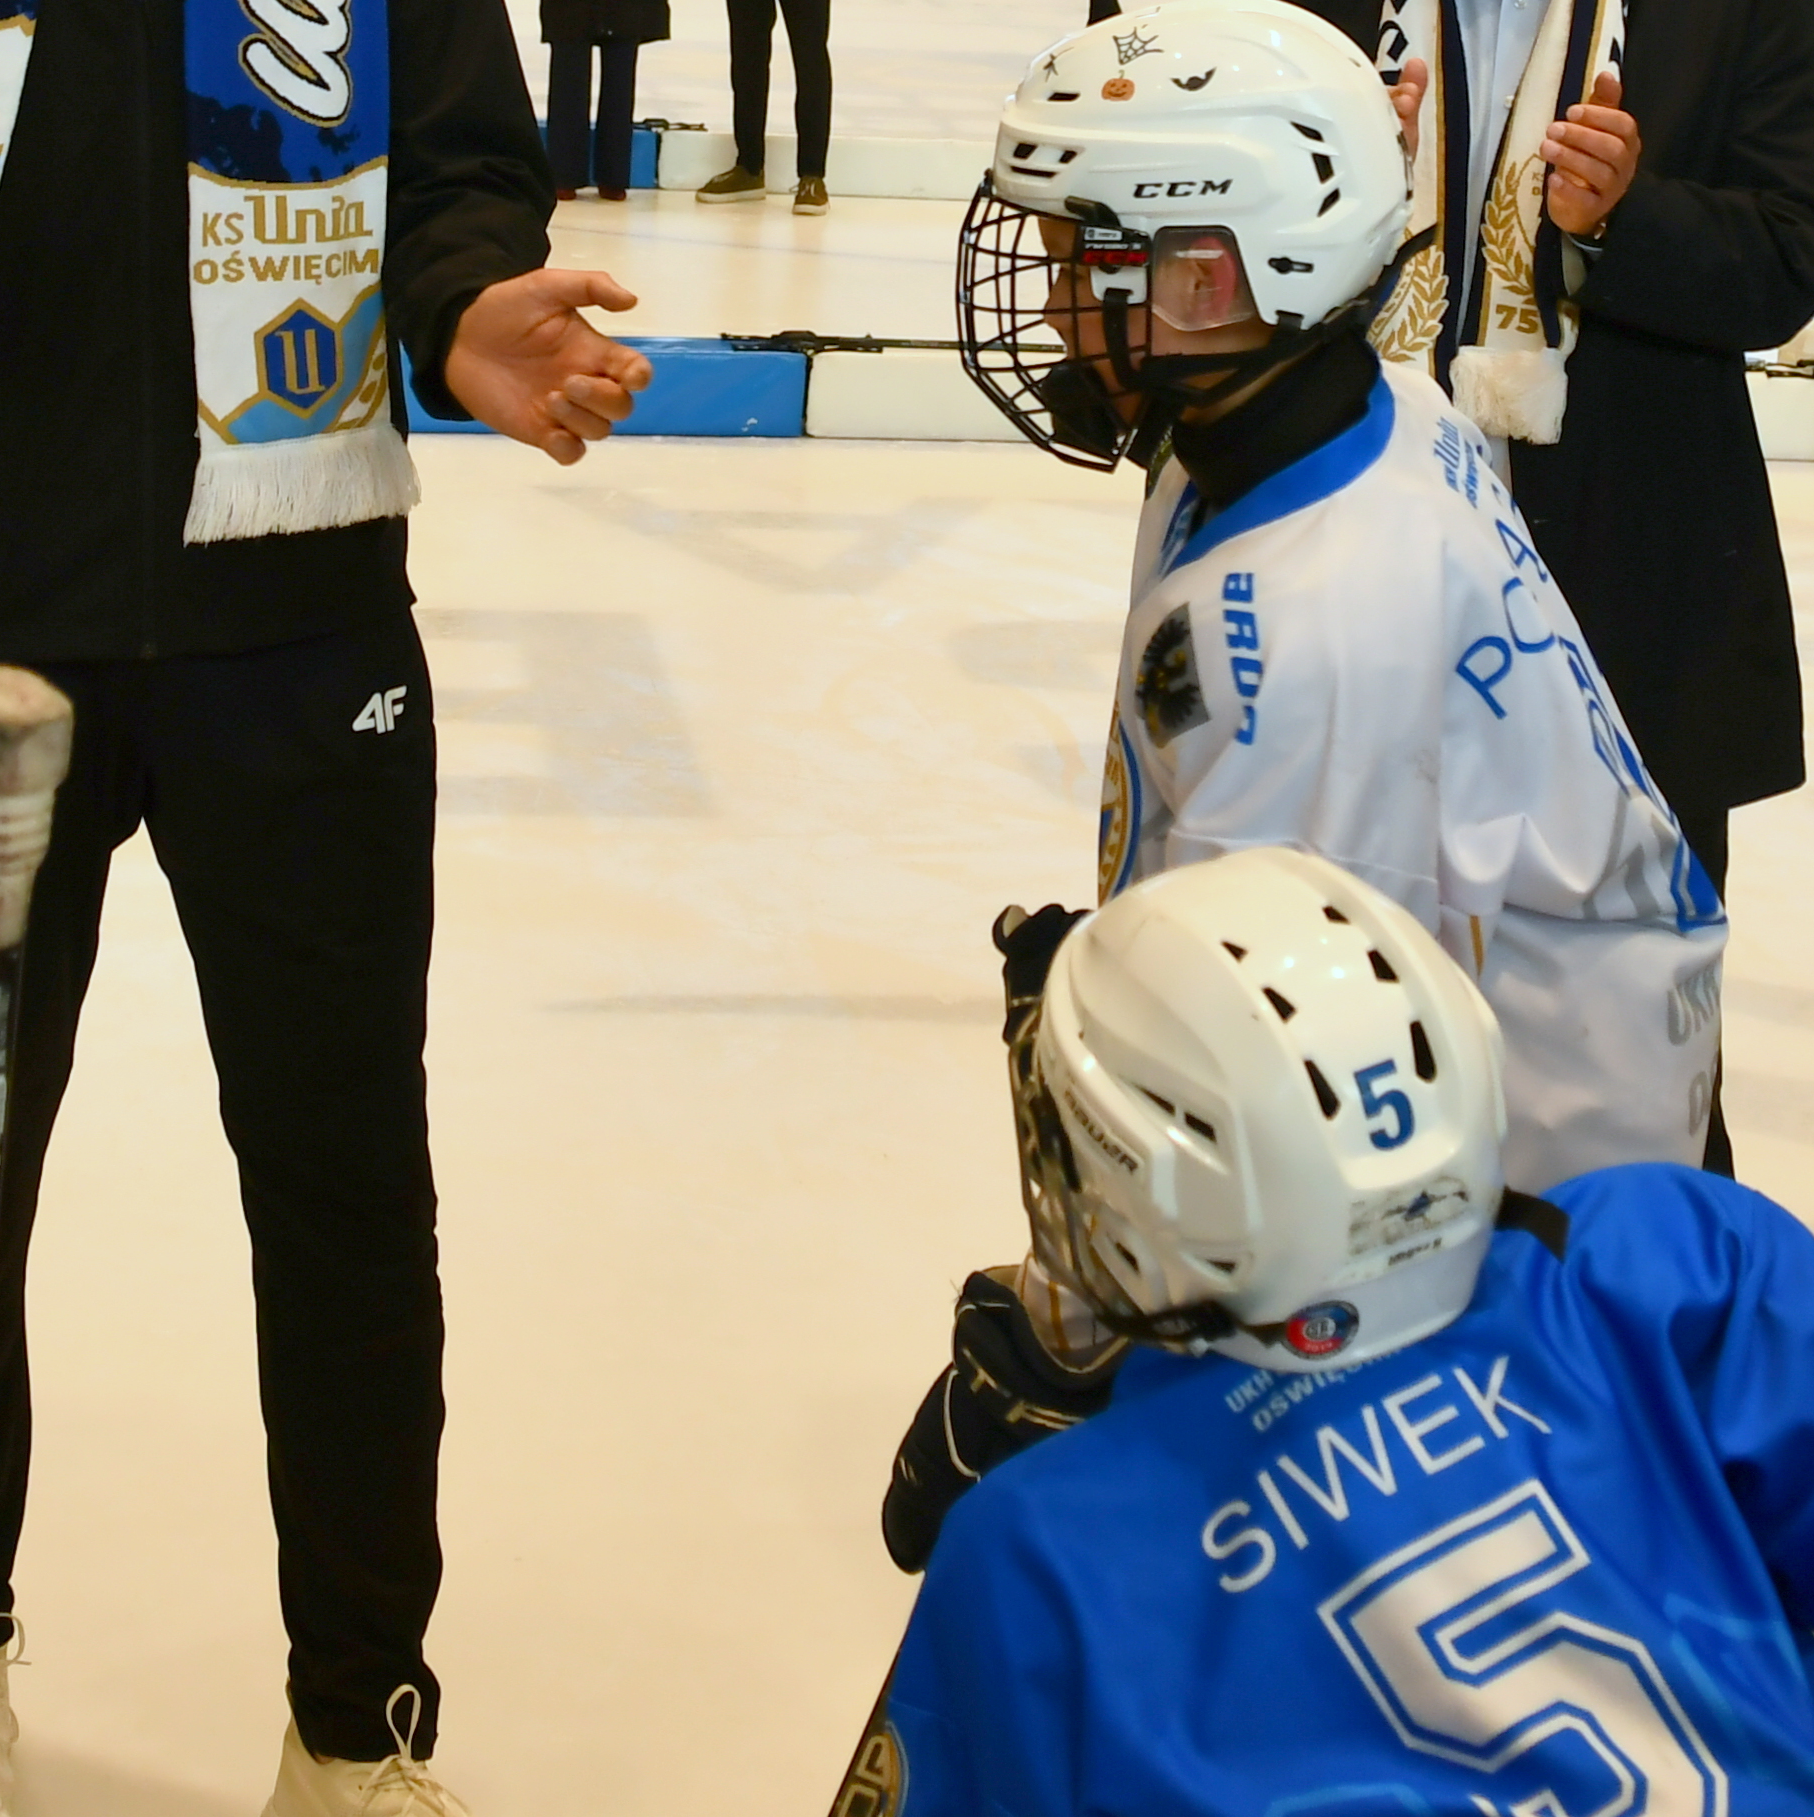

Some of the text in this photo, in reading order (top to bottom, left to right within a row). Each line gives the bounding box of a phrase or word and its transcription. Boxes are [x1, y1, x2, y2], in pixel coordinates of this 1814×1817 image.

[1133, 178, 1233, 199] CCM
[202, 195, 373, 247] KS Unia
[194, 248, 379, 286] OŚWIĘCIM
[1496, 304, 1539, 333] 75
[352, 685, 407, 734] 4F
[1353, 1058, 1415, 1151] 5
[1200, 1355, 1554, 1595] SIWEK
[1317, 1479, 1729, 1817] 5
